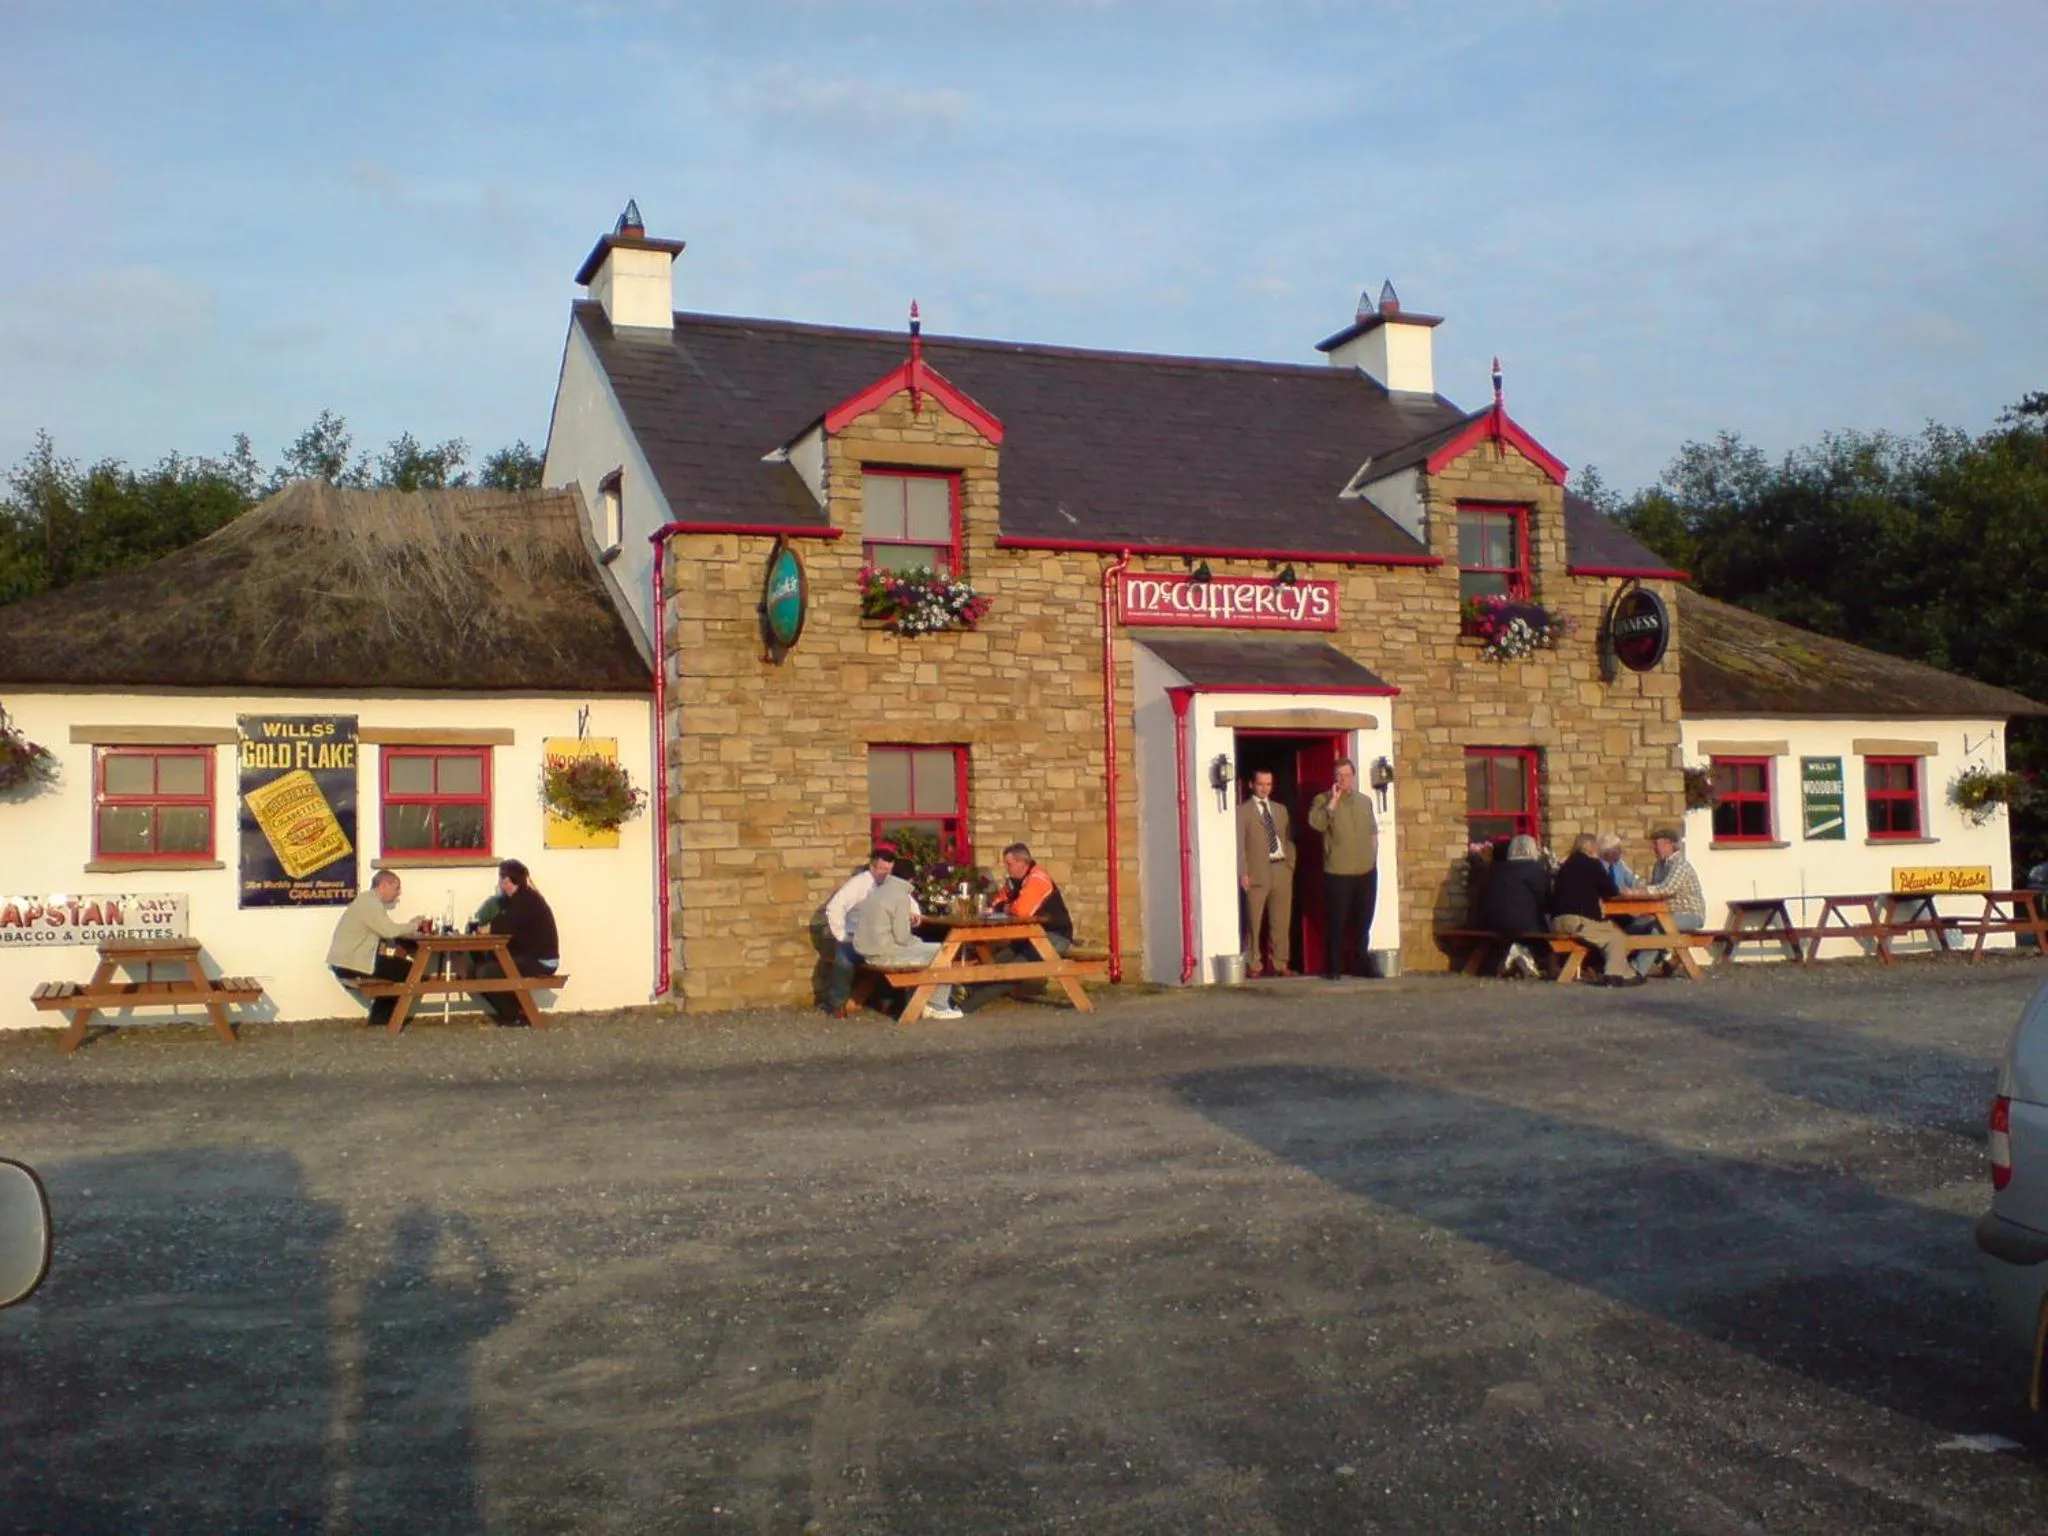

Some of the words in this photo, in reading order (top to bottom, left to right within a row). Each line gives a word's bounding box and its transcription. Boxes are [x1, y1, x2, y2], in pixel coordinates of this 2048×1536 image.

[242, 741, 292, 769] GOLD
[296, 741, 354, 769] FLAKE
[1949, 871, 1986, 891] Please
[141, 913, 173, 924] CUT
[0, 930, 55, 942] BACCO
[62, 930, 73, 941] &
